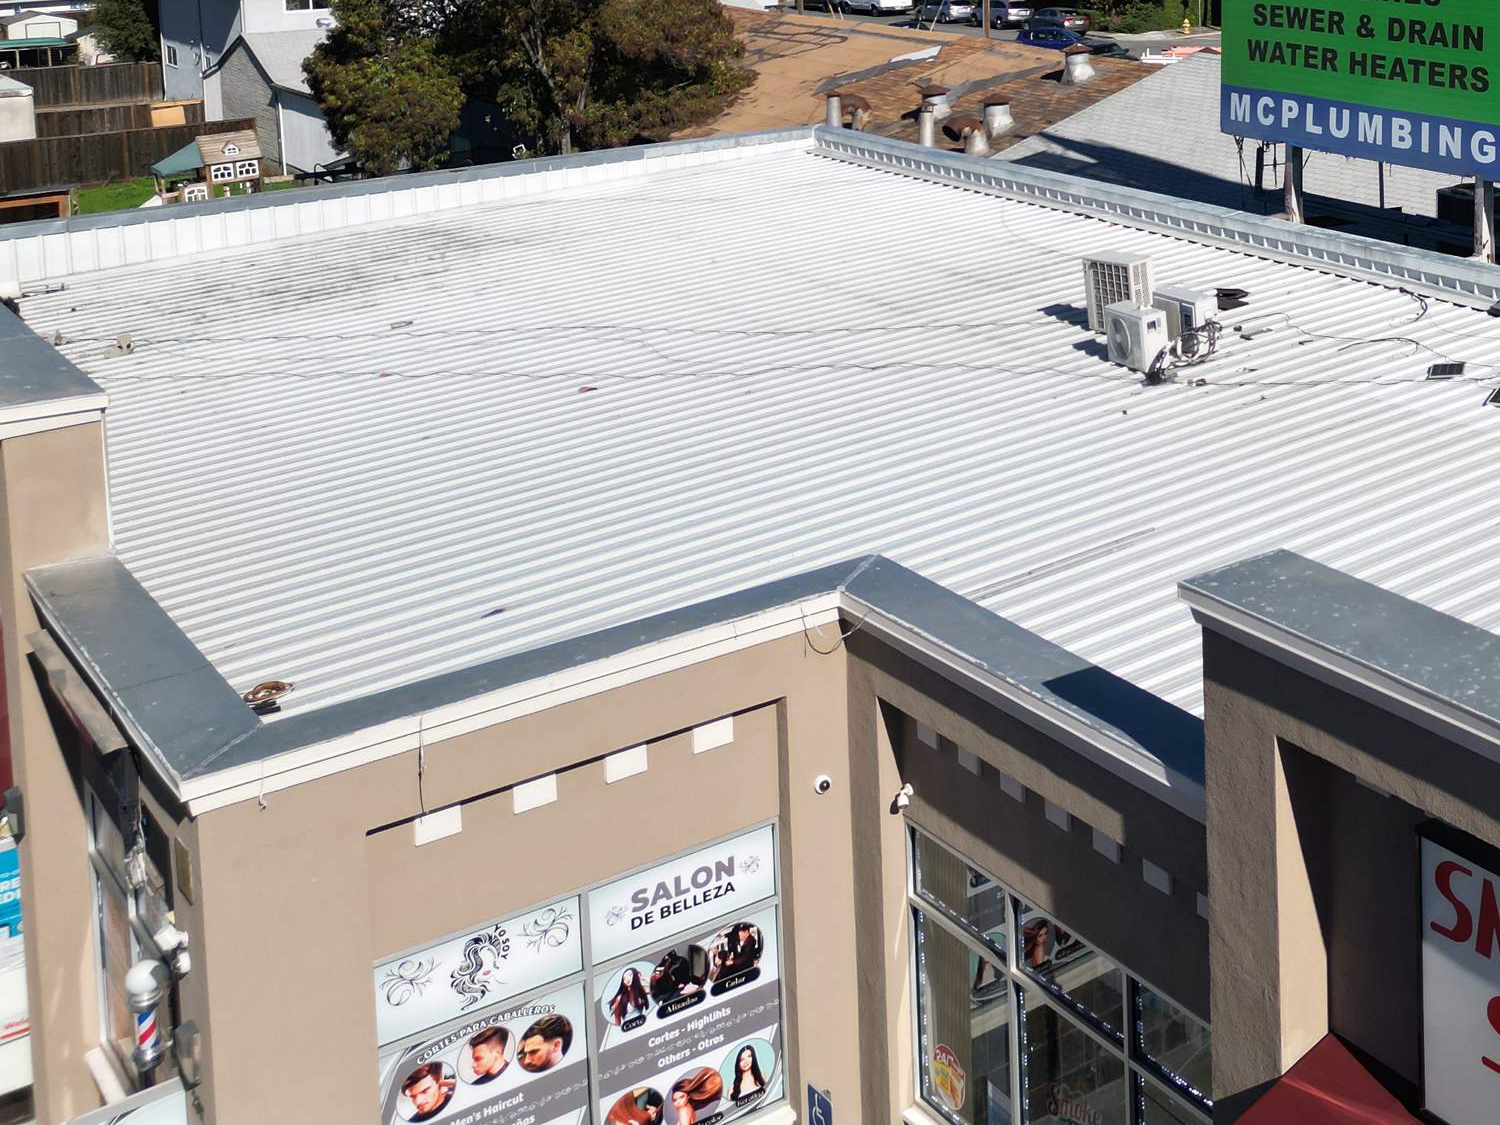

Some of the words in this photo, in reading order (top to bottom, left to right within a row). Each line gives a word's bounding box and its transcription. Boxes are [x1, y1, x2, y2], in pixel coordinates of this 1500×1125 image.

[1253, 3, 1345, 35] SEWER
[1356, 14, 1376, 38] &
[1388, 19, 1484, 52] DRAIN
[1247, 39, 1338, 73] WATER
[1349, 51, 1490, 93] HEATERS
[631, 856, 735, 913] SALON
[631, 911, 654, 930] DE
[660, 882, 735, 919] BELLEZA
[501, 938, 510, 959] SOY
[416, 1034, 457, 1065] CORTES
[460, 1020, 487, 1037] PARA
[489, 1005, 556, 1025] CABALLEROS
[648, 1029, 680, 1047] Cortes
[658, 1049, 690, 1067] Others
[698, 1034, 725, 1050] Otros
[483, 1092, 525, 1117] Haircut
